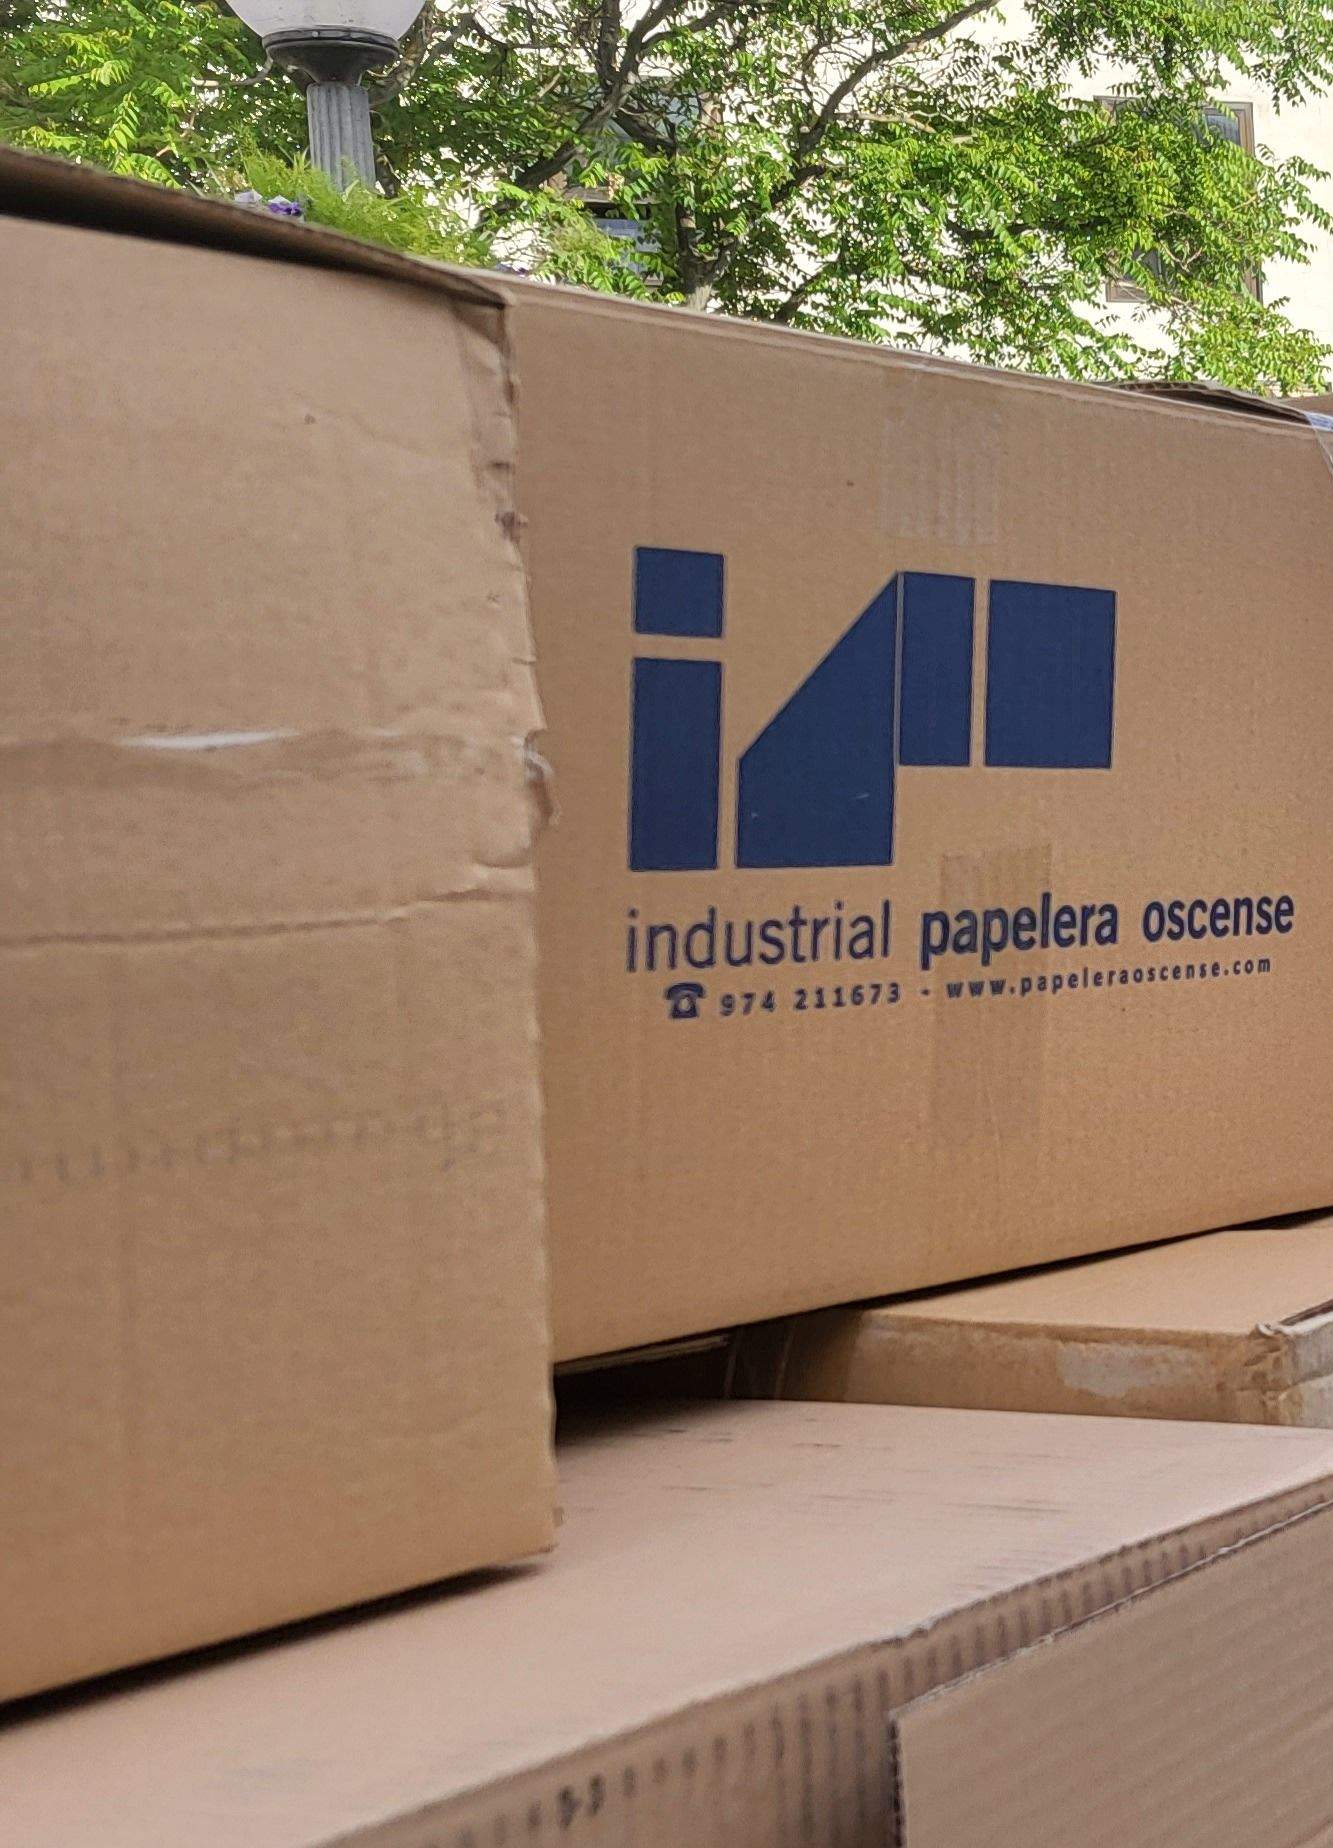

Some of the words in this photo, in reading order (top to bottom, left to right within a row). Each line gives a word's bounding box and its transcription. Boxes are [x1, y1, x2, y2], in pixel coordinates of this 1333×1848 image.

[625, 899, 891, 973] industrial
[920, 892, 1119, 971] papelera
[1142, 895, 1295, 943] oscense
[720, 990, 776, 1016] 974
[793, 982, 900, 1010] 211673
[946, 956, 1272, 999] www.papeleraoscense.com
